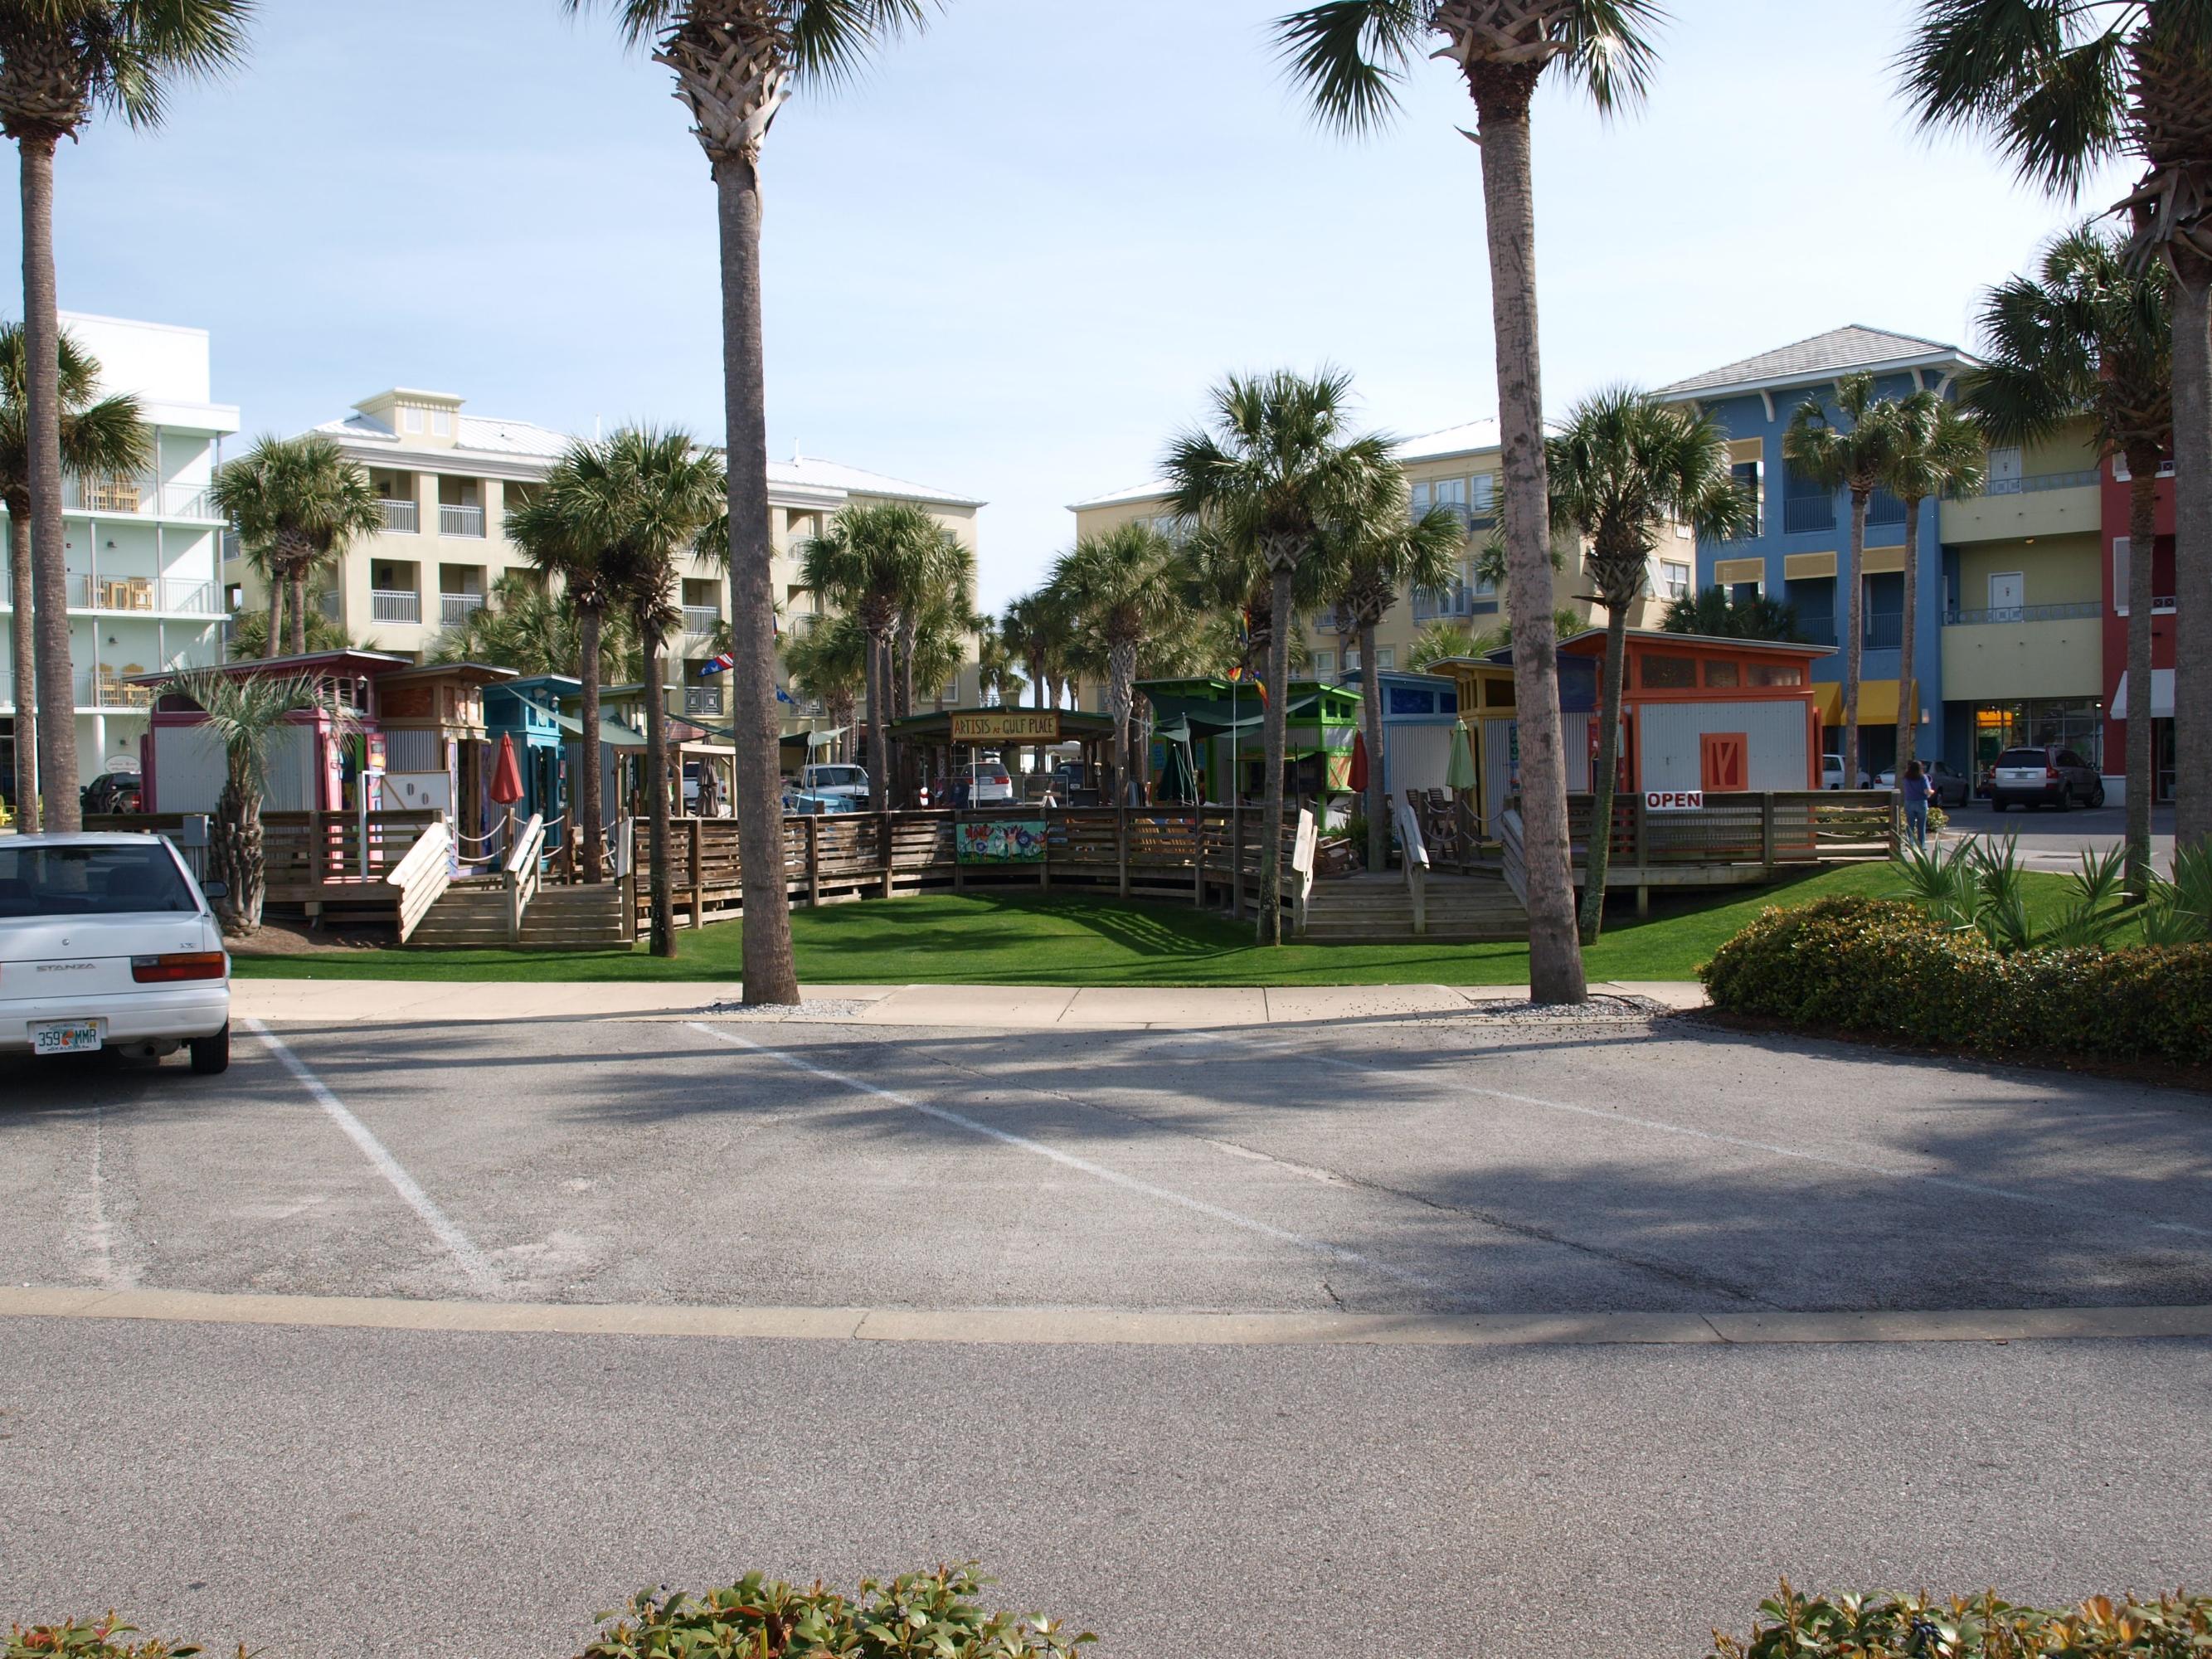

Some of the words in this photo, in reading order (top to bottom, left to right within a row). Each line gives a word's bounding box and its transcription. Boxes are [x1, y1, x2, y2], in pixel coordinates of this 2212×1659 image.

[955, 718, 990, 734] ARTISTS
[1003, 718, 1026, 734] GULF
[1029, 718, 1053, 733] PLACE
[1647, 793, 1700, 808] OPEN
[36, 963, 96, 971] STANZA
[38, 1031, 61, 1047] 359
[75, 1029, 97, 1044] MMR
